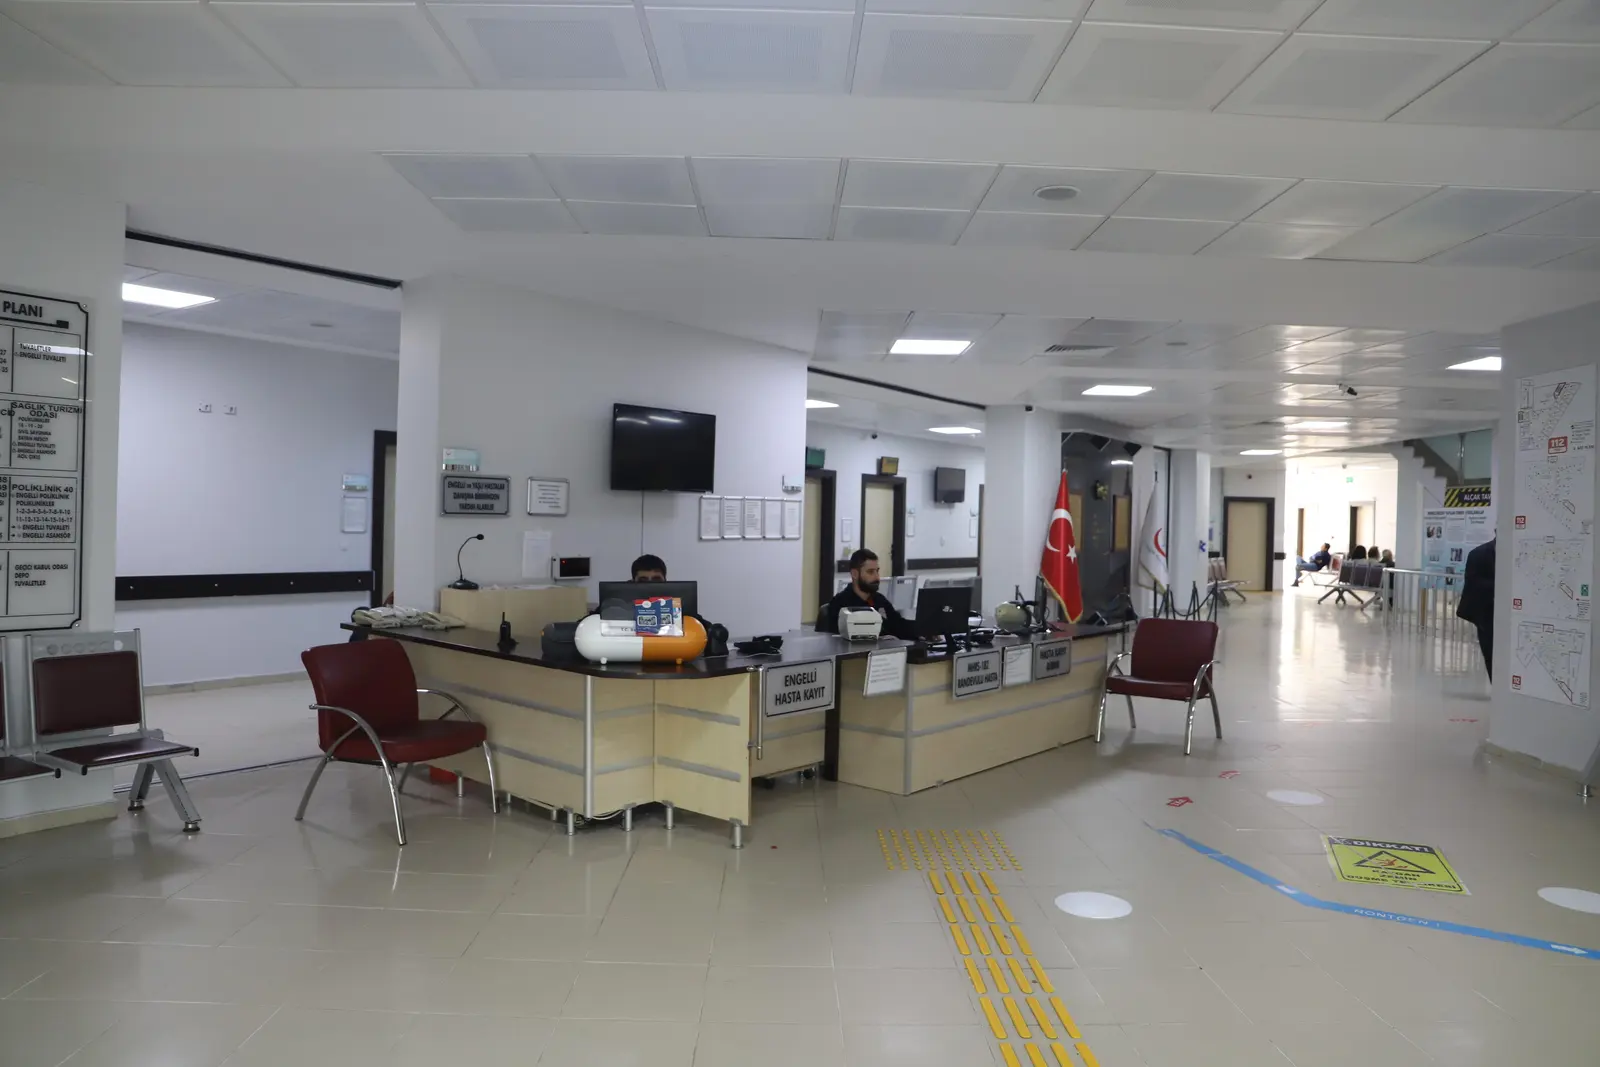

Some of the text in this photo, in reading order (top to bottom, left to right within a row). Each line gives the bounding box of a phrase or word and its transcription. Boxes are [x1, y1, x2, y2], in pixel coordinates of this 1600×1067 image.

[3, 300, 43, 318] PLANI
[29, 409, 57, 419] ODASI
[1551, 438, 1566, 448] 112
[12, 483, 62, 492] POLİKLİNİK
[784, 667, 817, 688] ENGELLİ
[775, 686, 826, 706] HASTA KAYIT
